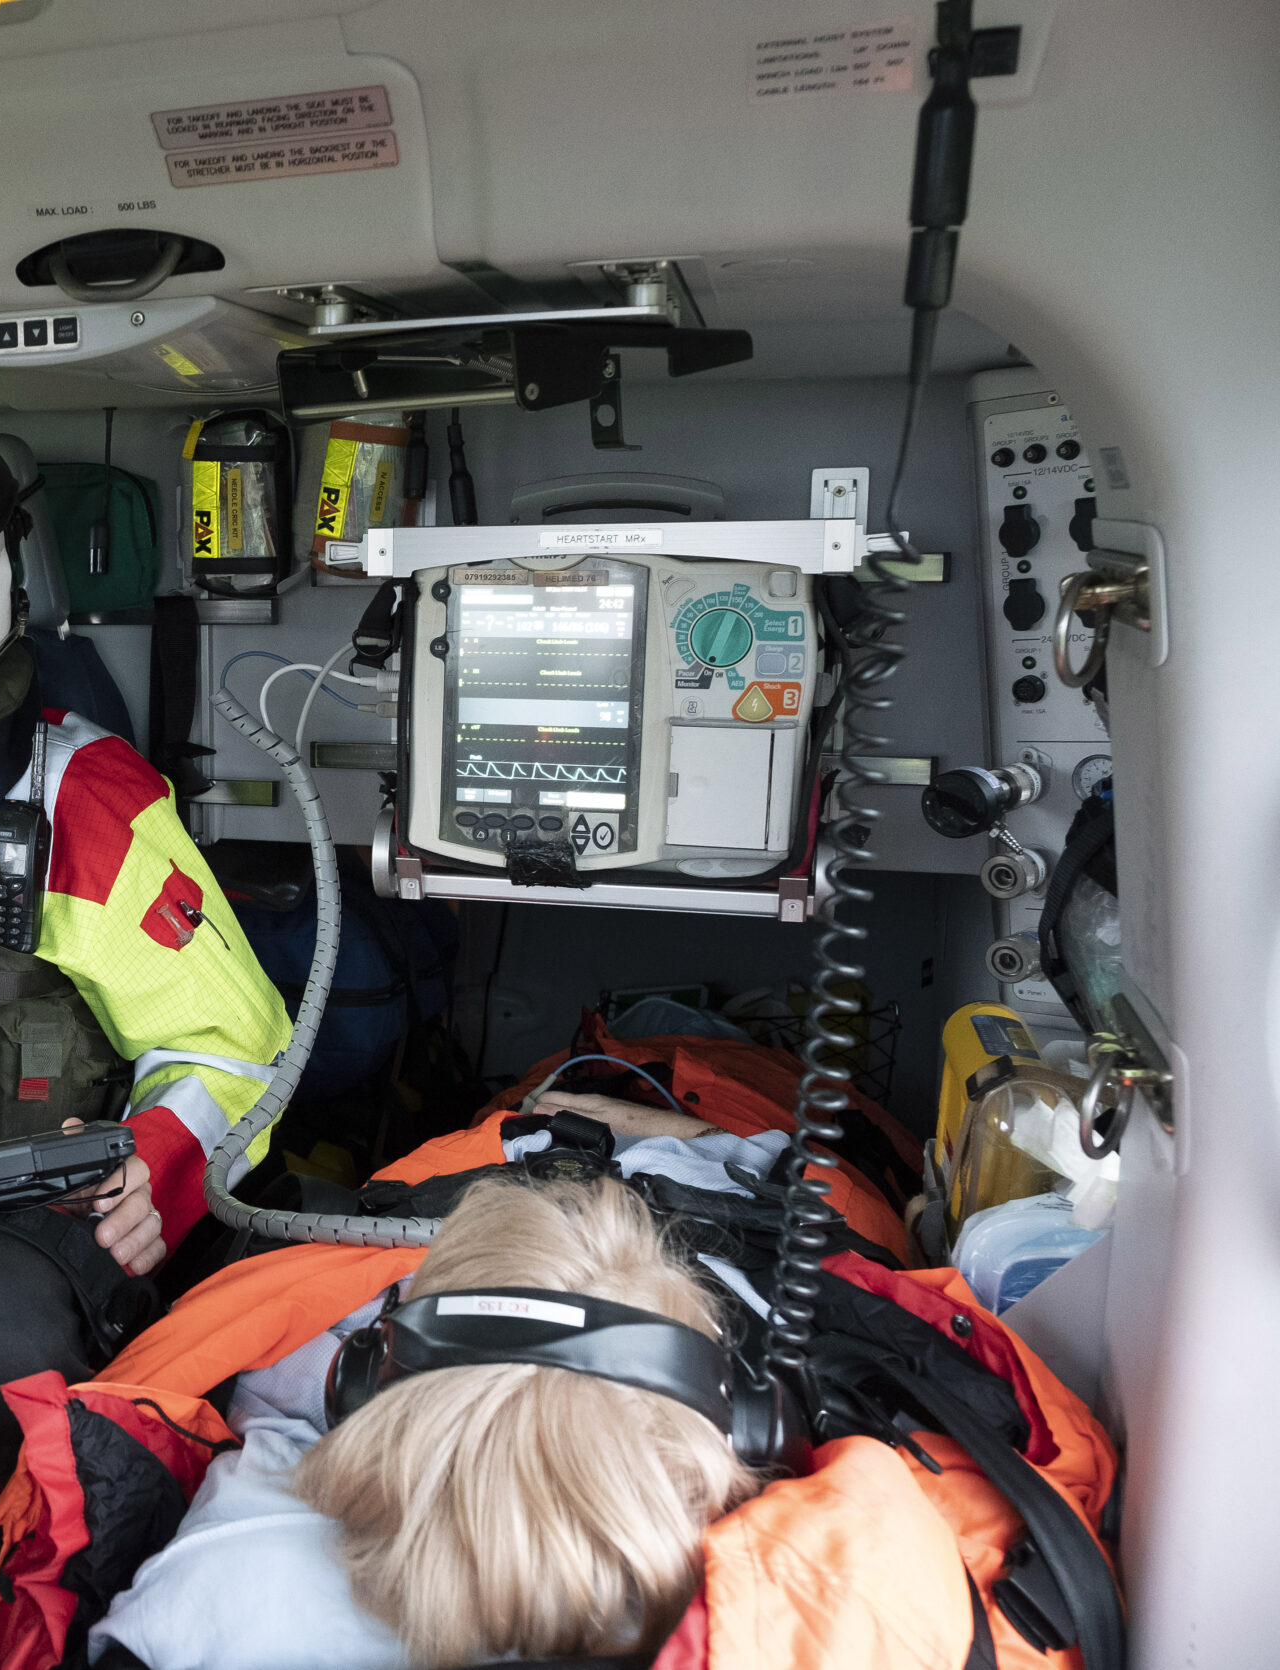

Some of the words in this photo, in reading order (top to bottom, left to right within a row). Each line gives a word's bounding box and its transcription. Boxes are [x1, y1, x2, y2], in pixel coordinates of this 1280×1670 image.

[167, 117, 184, 126] FOR
[187, 113, 221, 124] TAKEOFF
[226, 110, 243, 119] AND
[246, 105, 281, 116] LANDING
[285, 103, 301, 112] THE
[305, 101, 326, 110] SEAT
[331, 98, 354, 107] MUST
[358, 95, 369, 104] BE
[166, 125, 198, 135] LOCKED
[214, 118, 258, 130] REARWARD
[261, 114, 291, 125] FACING
[295, 110, 338, 121] DIRECTION
[342, 107, 355, 115] ON
[359, 104, 375, 113] THE
[174, 160, 190, 169] FOR
[194, 156, 227, 167] TAKEOFF
[231, 154, 248, 162] AND
[251, 149, 286, 161] LANDING
[290, 148, 305, 156] THE
[308, 142, 350, 154] BACKREST
[355, 141, 366, 149] OF
[370, 138, 388, 148] THE
[186, 166, 231, 178] STRETCHER
[234, 163, 256, 172] MUST
[259, 162, 271, 170] BE
[275, 160, 284, 168] IN
[288, 154, 338, 167] HORIZONTAL
[342, 151, 379, 162] POSITION
[137, 200, 157, 210] LBS
[1032, 464, 1079, 476] 12/14VDC
[230, 478, 239, 507] NEEDLE
[373, 479, 387, 513] ACCESS
[317, 486, 341, 534] PAX
[194, 510, 213, 555] PAX
[231, 527, 239, 539] KIT
[557, 535, 619, 544] HEARTSTART
[625, 534, 646, 543] MRx
[465, 573, 516, 581] 07919292385
[545, 575, 584, 583] HELIMED
[662, 574, 675, 586] Sync
[763, 625, 786, 633] Energy
[790, 618, 798, 634] 1
[790, 655, 801, 670] 2
[786, 691, 796, 707] 3
